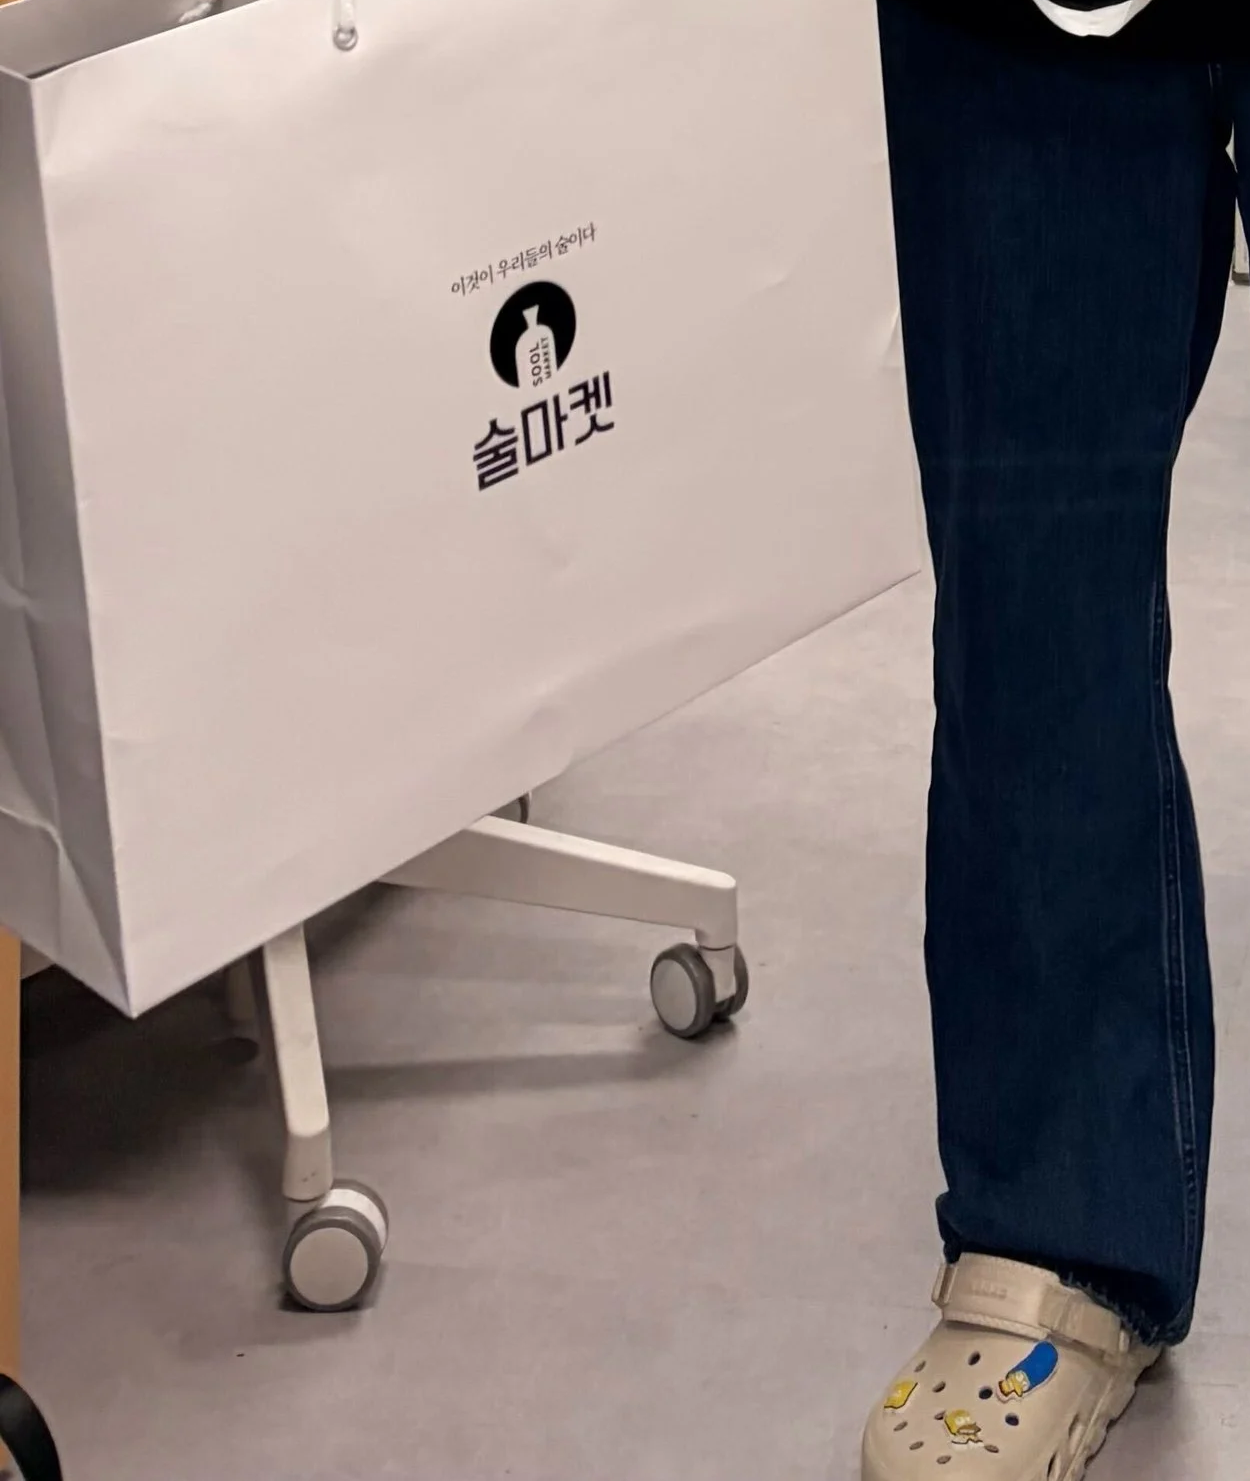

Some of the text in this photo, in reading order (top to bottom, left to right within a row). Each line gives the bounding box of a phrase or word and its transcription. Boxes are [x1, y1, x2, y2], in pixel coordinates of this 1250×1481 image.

[450, 221, 598, 297] 이것이 우리들의 술이다
[529, 340, 543, 387] SOOL
[473, 370, 615, 492] 술마켓
